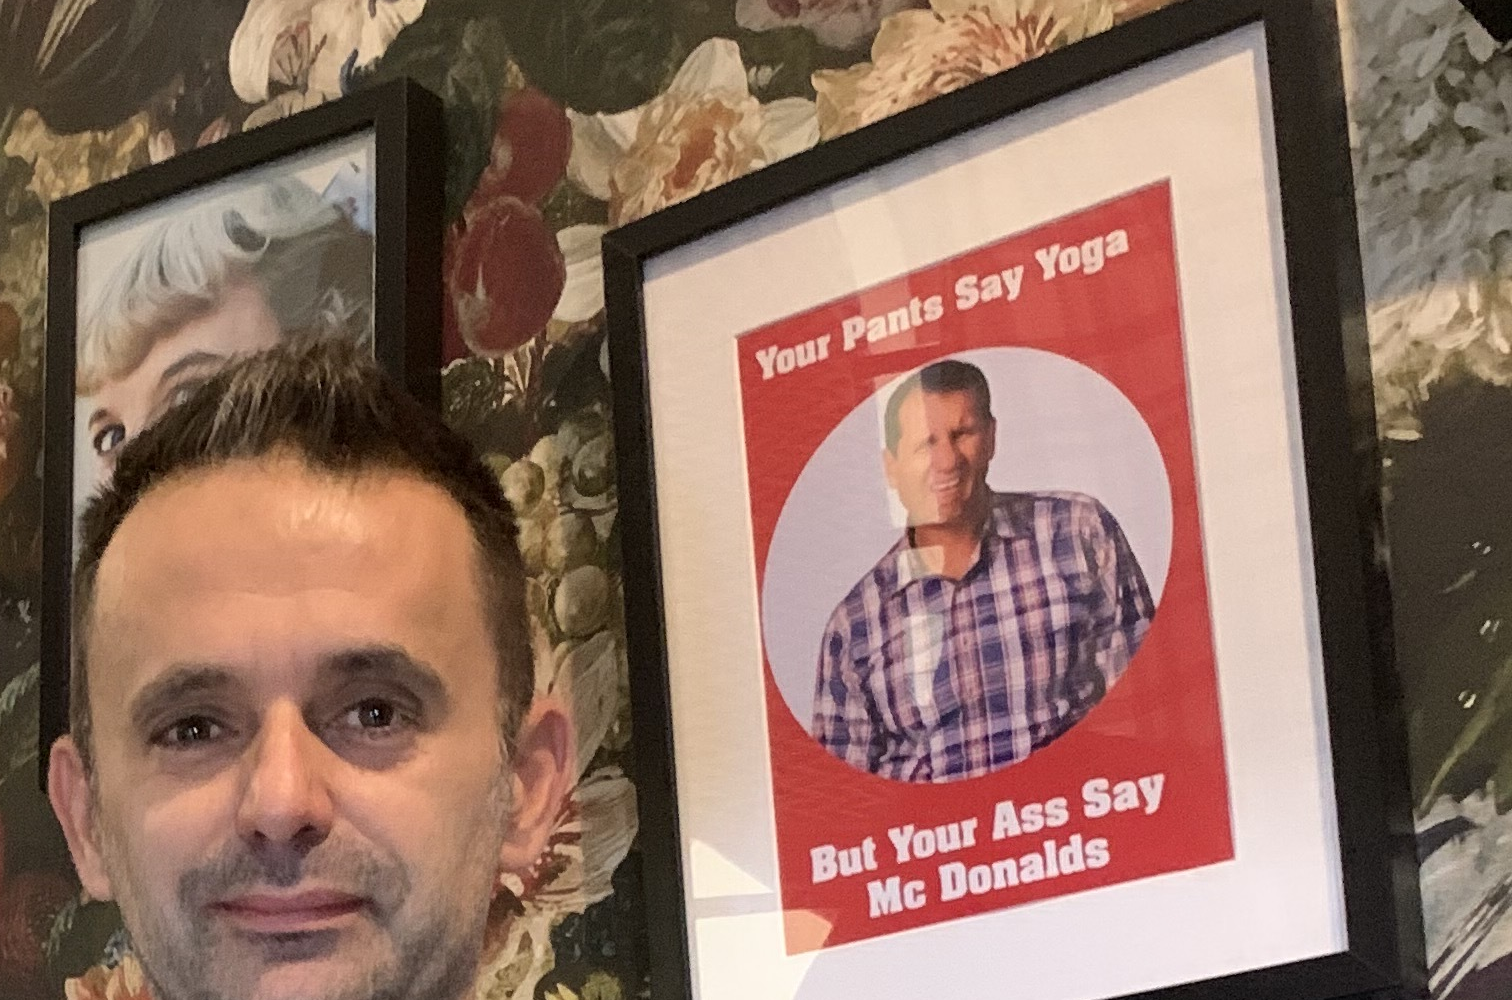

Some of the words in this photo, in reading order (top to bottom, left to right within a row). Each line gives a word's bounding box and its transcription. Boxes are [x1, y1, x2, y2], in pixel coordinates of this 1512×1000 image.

[756, 333, 831, 381] Your
[842, 295, 944, 351] Pants
[955, 265, 1024, 311] Say
[1034, 229, 1130, 281] Yoga
[810, 836, 878, 884] But
[888, 817, 978, 864] Your
[992, 797, 1069, 841] Ass
[1082, 773, 1165, 818] Say
[867, 876, 926, 919] Mc
[938, 833, 1110, 902] Donalds
